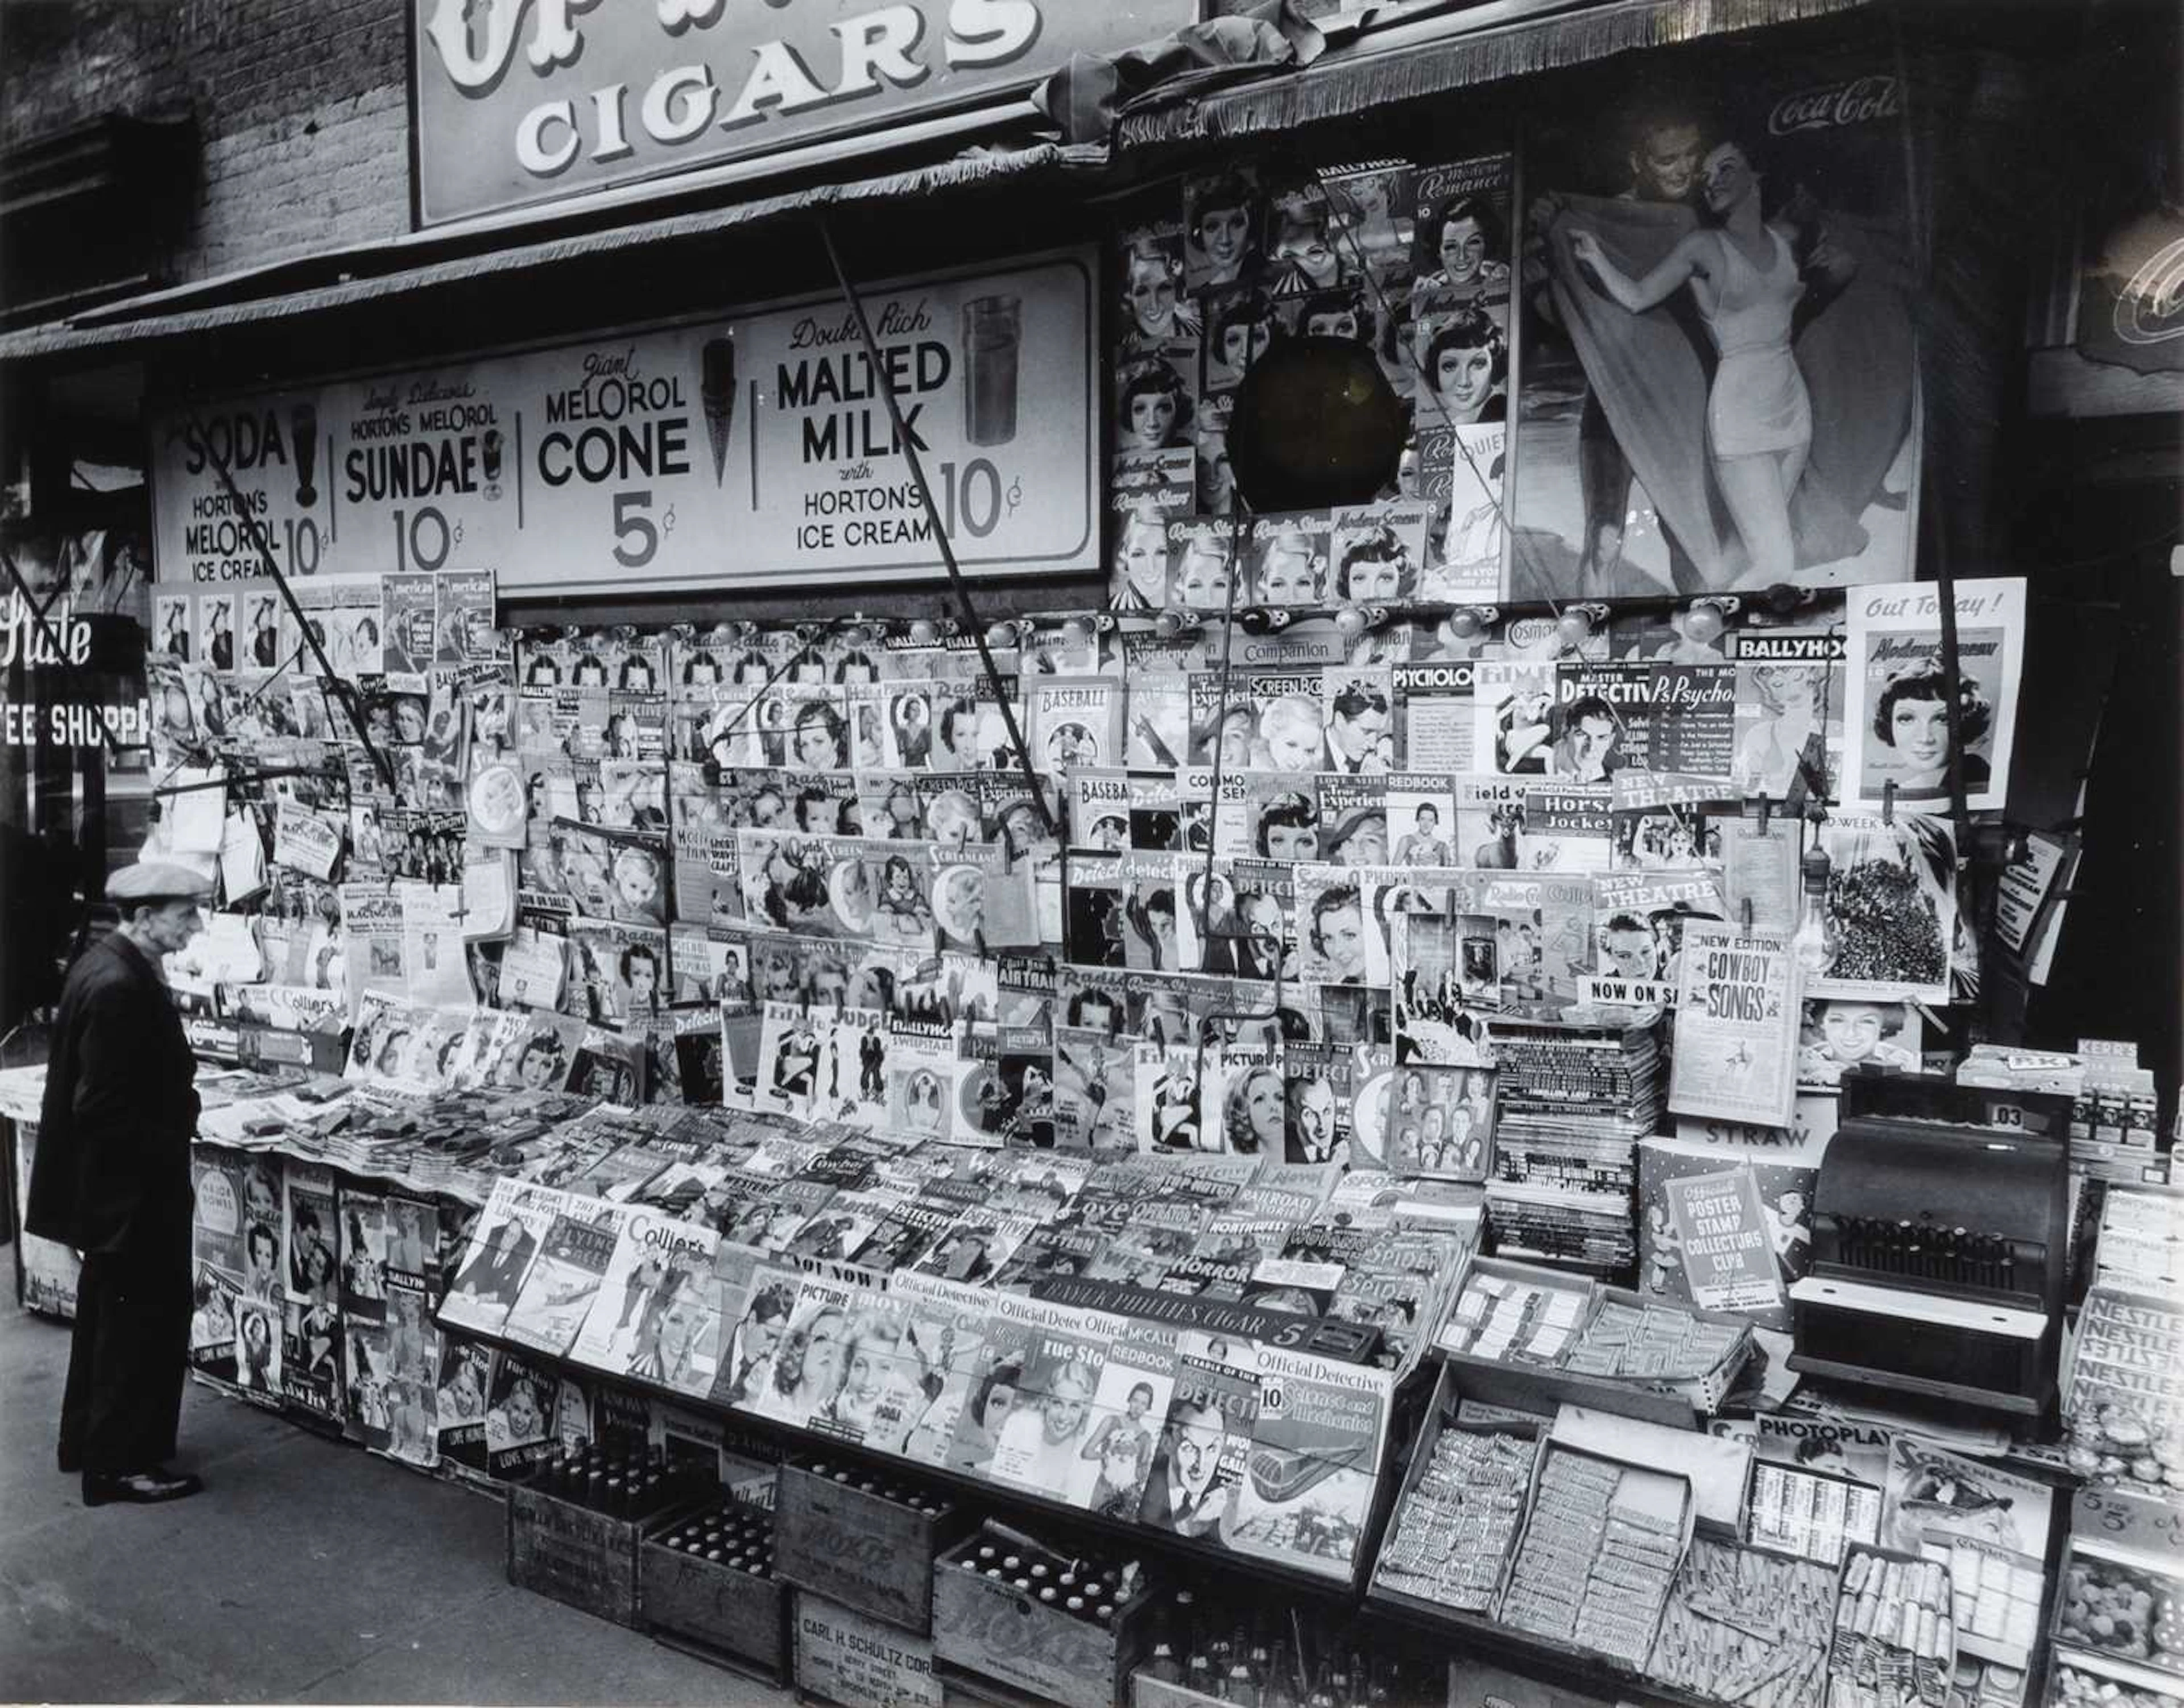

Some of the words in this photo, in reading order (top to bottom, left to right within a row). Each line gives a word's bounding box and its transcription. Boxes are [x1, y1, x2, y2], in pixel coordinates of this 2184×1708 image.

[515, 0, 1042, 177] CIGARS
[789, 316, 863, 350] Doubl
[877, 298, 933, 339] Rich
[777, 340, 953, 411] MALTED
[547, 373, 686, 425] MELOROL
[350, 413, 412, 441] HORTON'S
[419, 402, 499, 431] MELOROL
[802, 402, 933, 464] MILK
[185, 407, 289, 475] SODA
[538, 417, 690, 486] CONE
[346, 429, 479, 504] SUNDAE
[804, 481, 924, 518] HORTON'S
[797, 521, 834, 550] ICE
[844, 516, 933, 548] CREAM
[193, 561, 217, 582] ICE
[1866, 597, 1906, 618] Out
[1914, 593, 1984, 618] Toay
[1040, 686, 1107, 713] BASEBALL
[0, 702, 36, 746] EE
[1388, 775, 1450, 790] REDBOOK
[1603, 879, 1715, 908] THEATRE
[1708, 953, 1771, 983] COWBOY
[1592, 982, 1627, 999] NOW
[1635, 986, 1656, 1002] ON
[1707, 983, 1765, 1023] SONGS
[1706, 1123, 1810, 1148] STRAW
[1686, 1194, 1743, 1219] POSTER
[628, 1214, 706, 1255] Collier's
[1695, 1214, 1742, 1236] STAMP
[1686, 1230, 1763, 1256] COLLECTORS
[1170, 1254, 1251, 1283] HORROR
[800, 1281, 850, 1308] PICTURE
[1000, 1300, 1046, 1327] Official
[1257, 1350, 1313, 1379] Official
[1312, 1363, 1385, 1392] Detective
[1761, 1417, 1892, 1448] PHOTOPLAY
[803, 1618, 834, 1643] CARL
[848, 1634, 903, 1667] SCHULTZ
